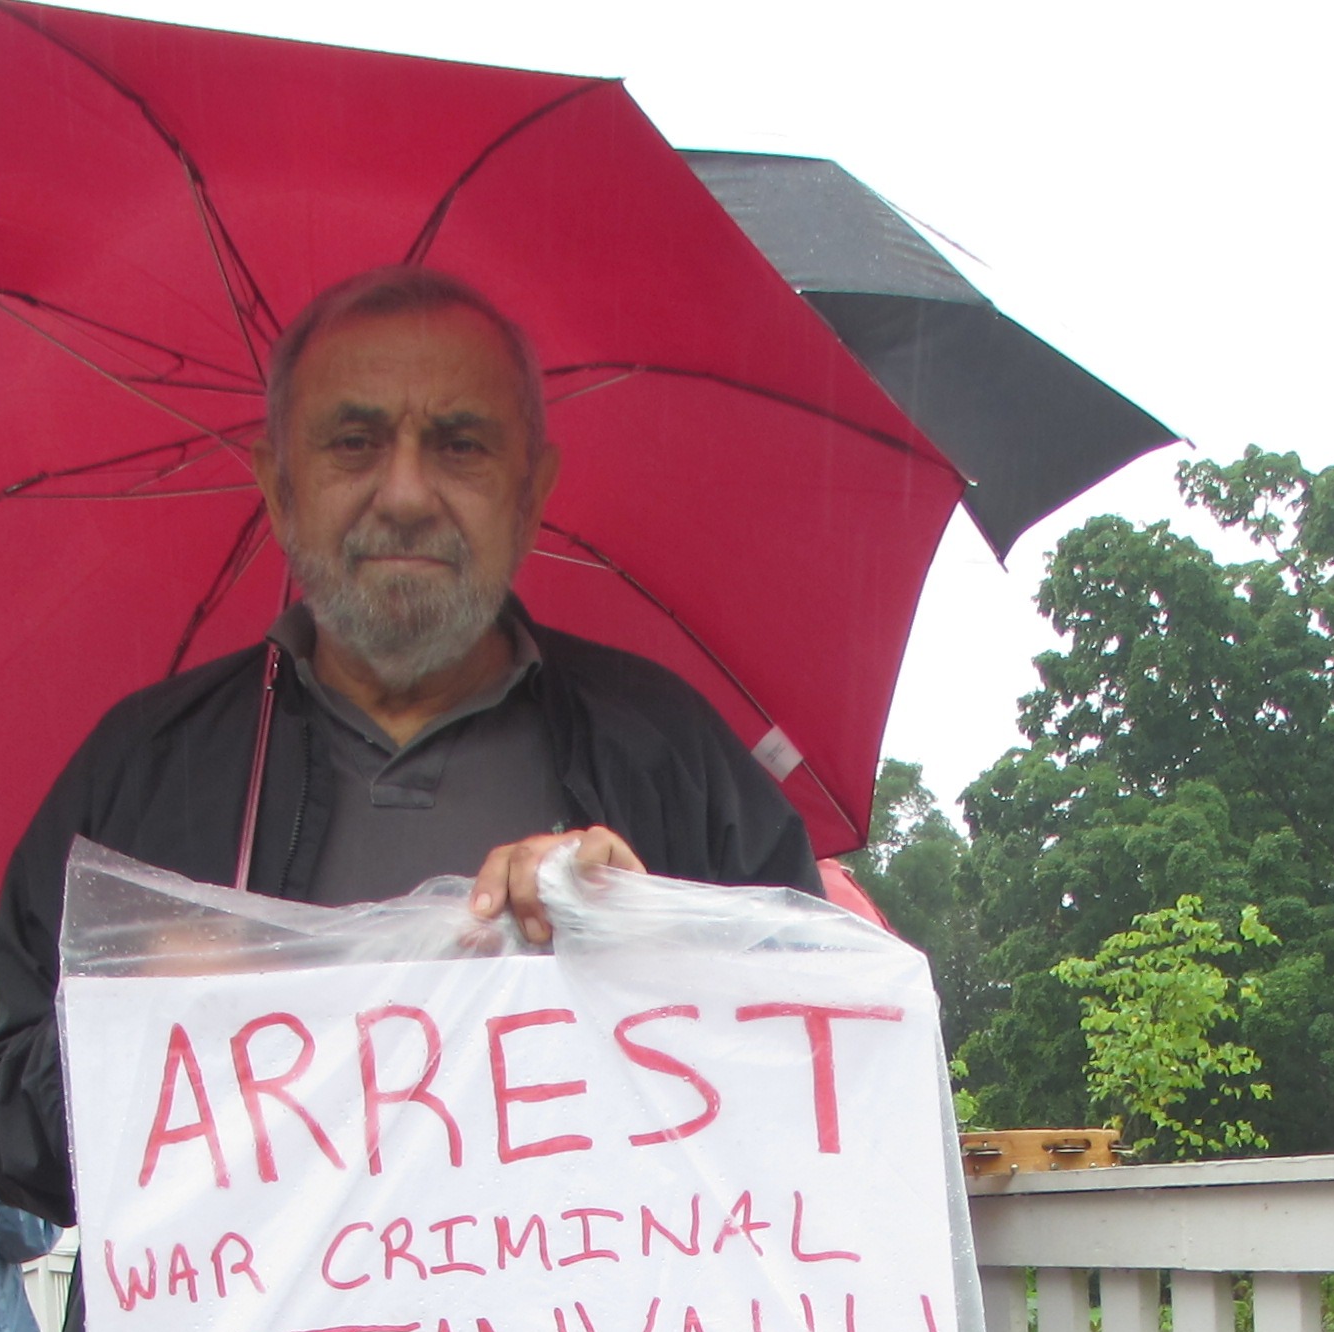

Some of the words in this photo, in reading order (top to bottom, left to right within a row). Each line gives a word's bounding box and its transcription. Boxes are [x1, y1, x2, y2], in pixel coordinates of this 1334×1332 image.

[138, 1003, 904, 1189] ARREST
[104, 1232, 266, 1311] WAR
[320, 1190, 861, 1291] CRIMINAL
